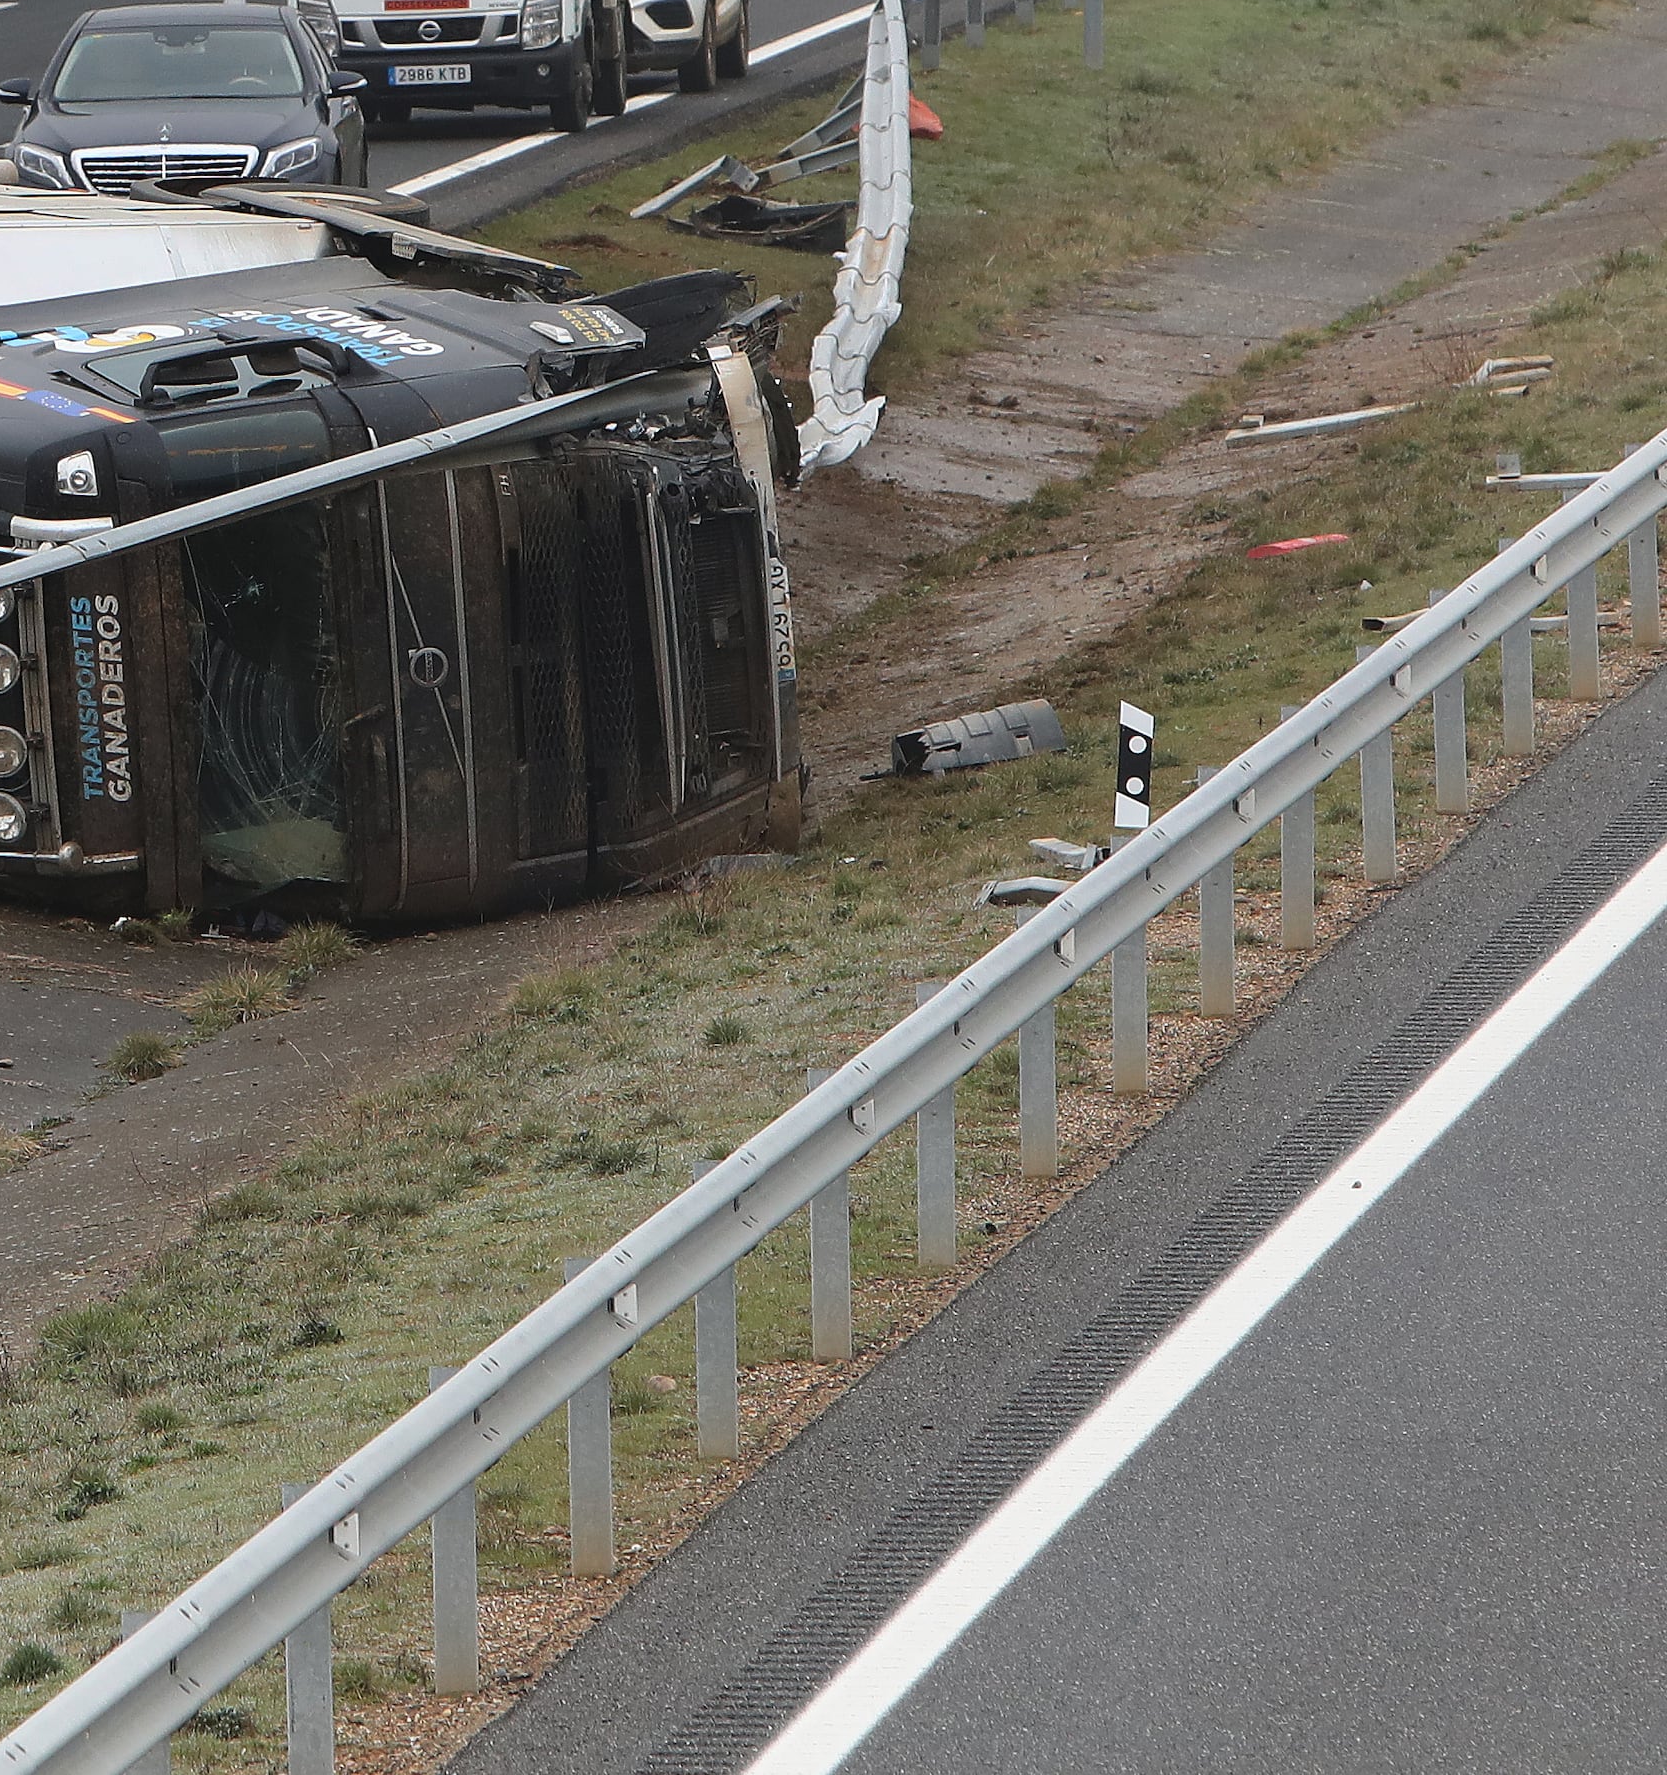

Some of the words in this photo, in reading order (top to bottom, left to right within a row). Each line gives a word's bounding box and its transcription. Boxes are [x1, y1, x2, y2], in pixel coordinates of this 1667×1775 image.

[398, 67, 434, 82] 2986
[439, 66, 466, 81] KTB
[70, 596, 105, 800] TRANSPORTES
[95, 594, 133, 802] GANADEROS
